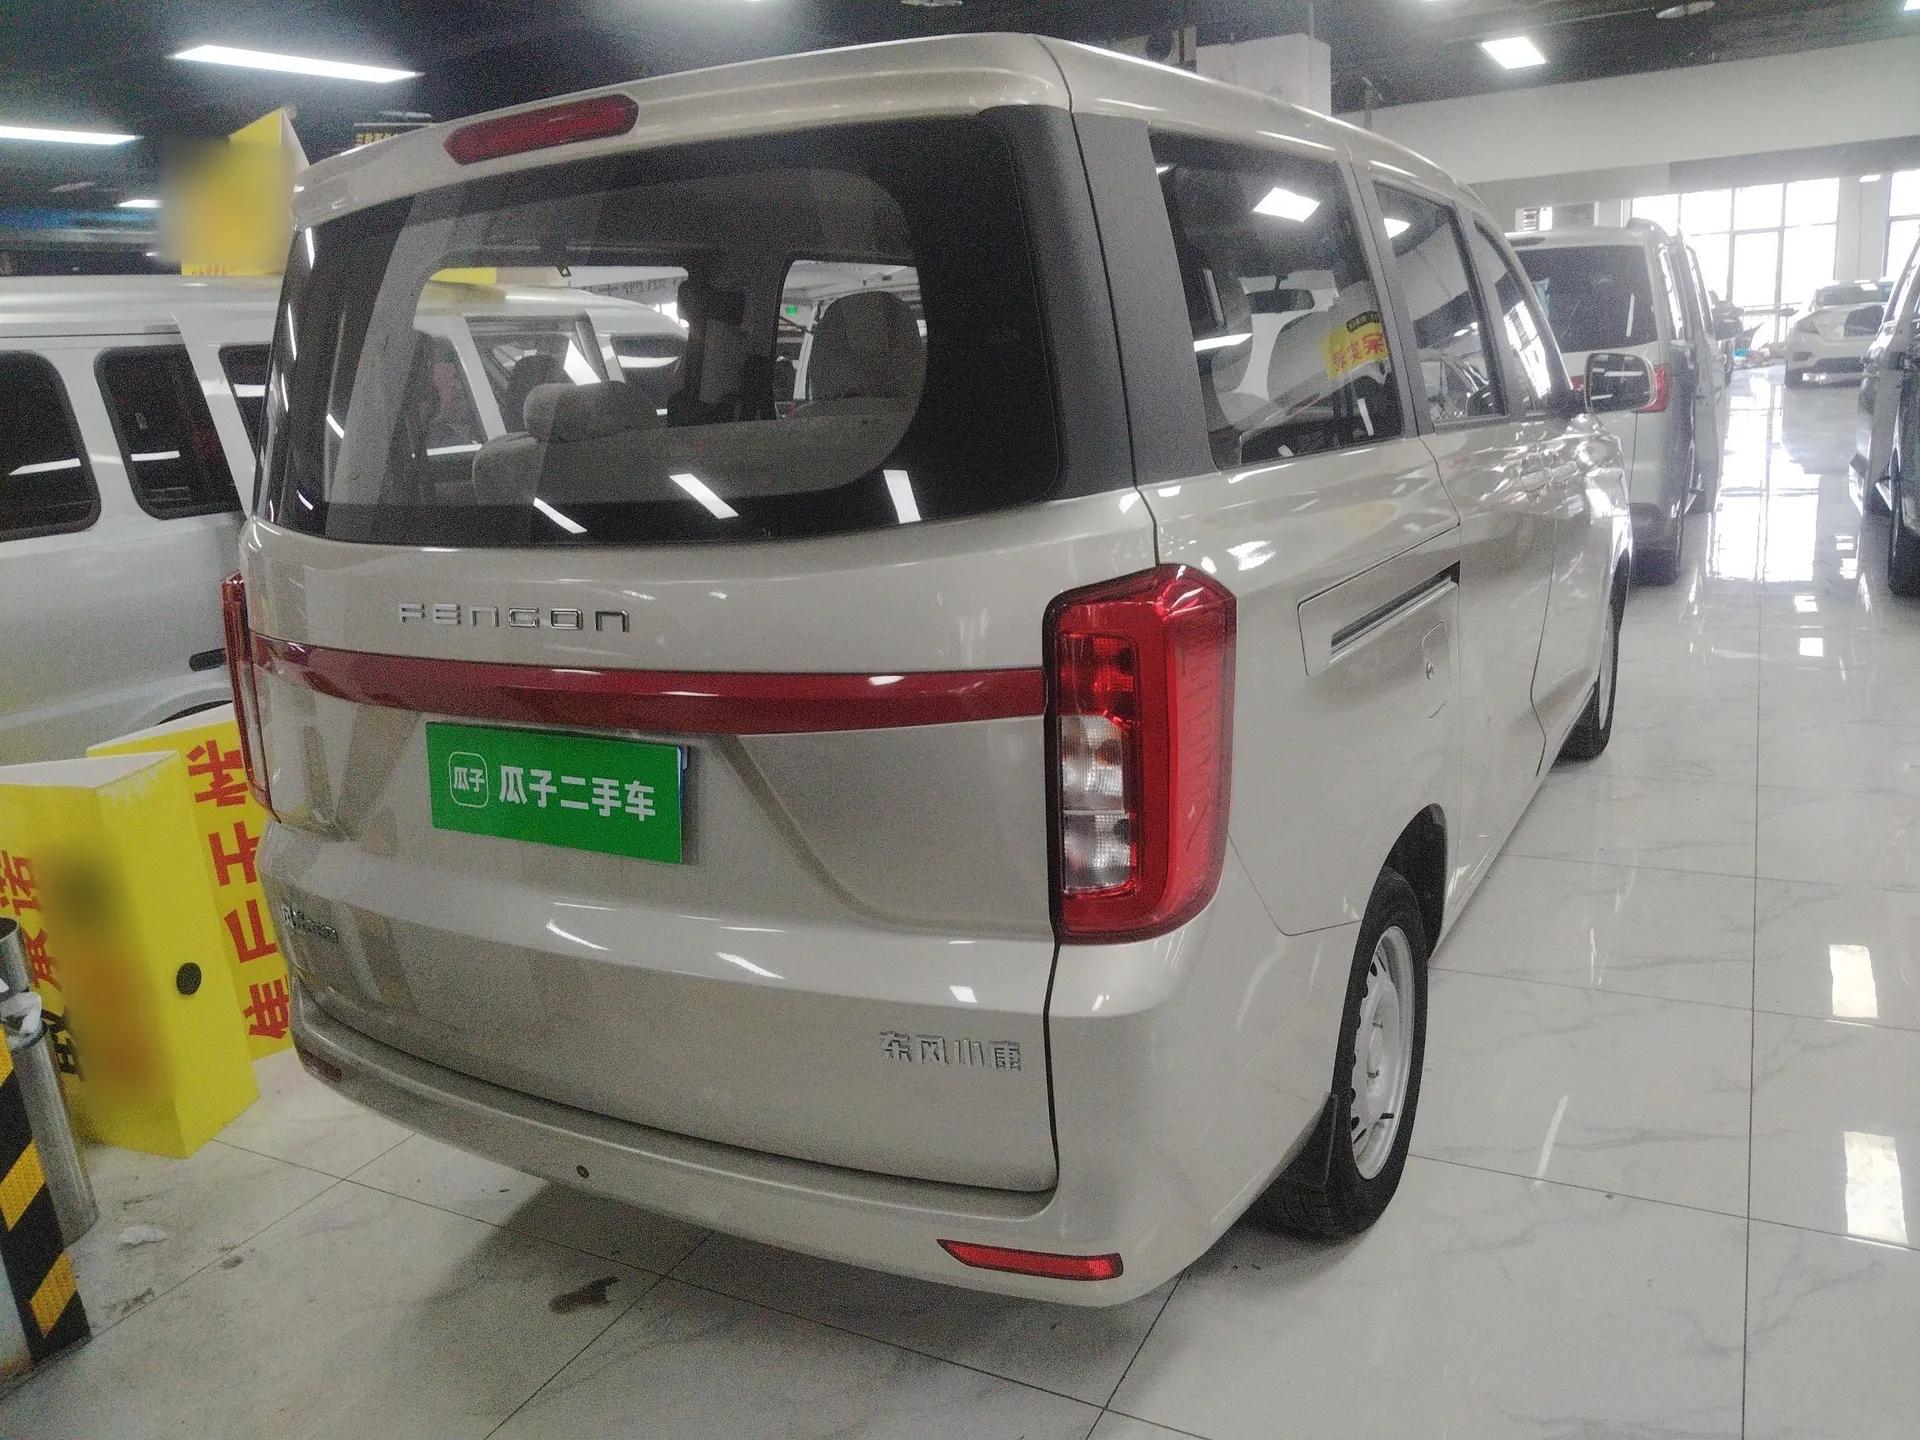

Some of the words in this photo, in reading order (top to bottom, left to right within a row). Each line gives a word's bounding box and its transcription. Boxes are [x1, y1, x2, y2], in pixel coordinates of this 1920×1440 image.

[453, 766, 486, 793] 瓜子
[498, 764, 657, 822] 瓜子二手车
[879, 1030, 1022, 1071] 东风小康
